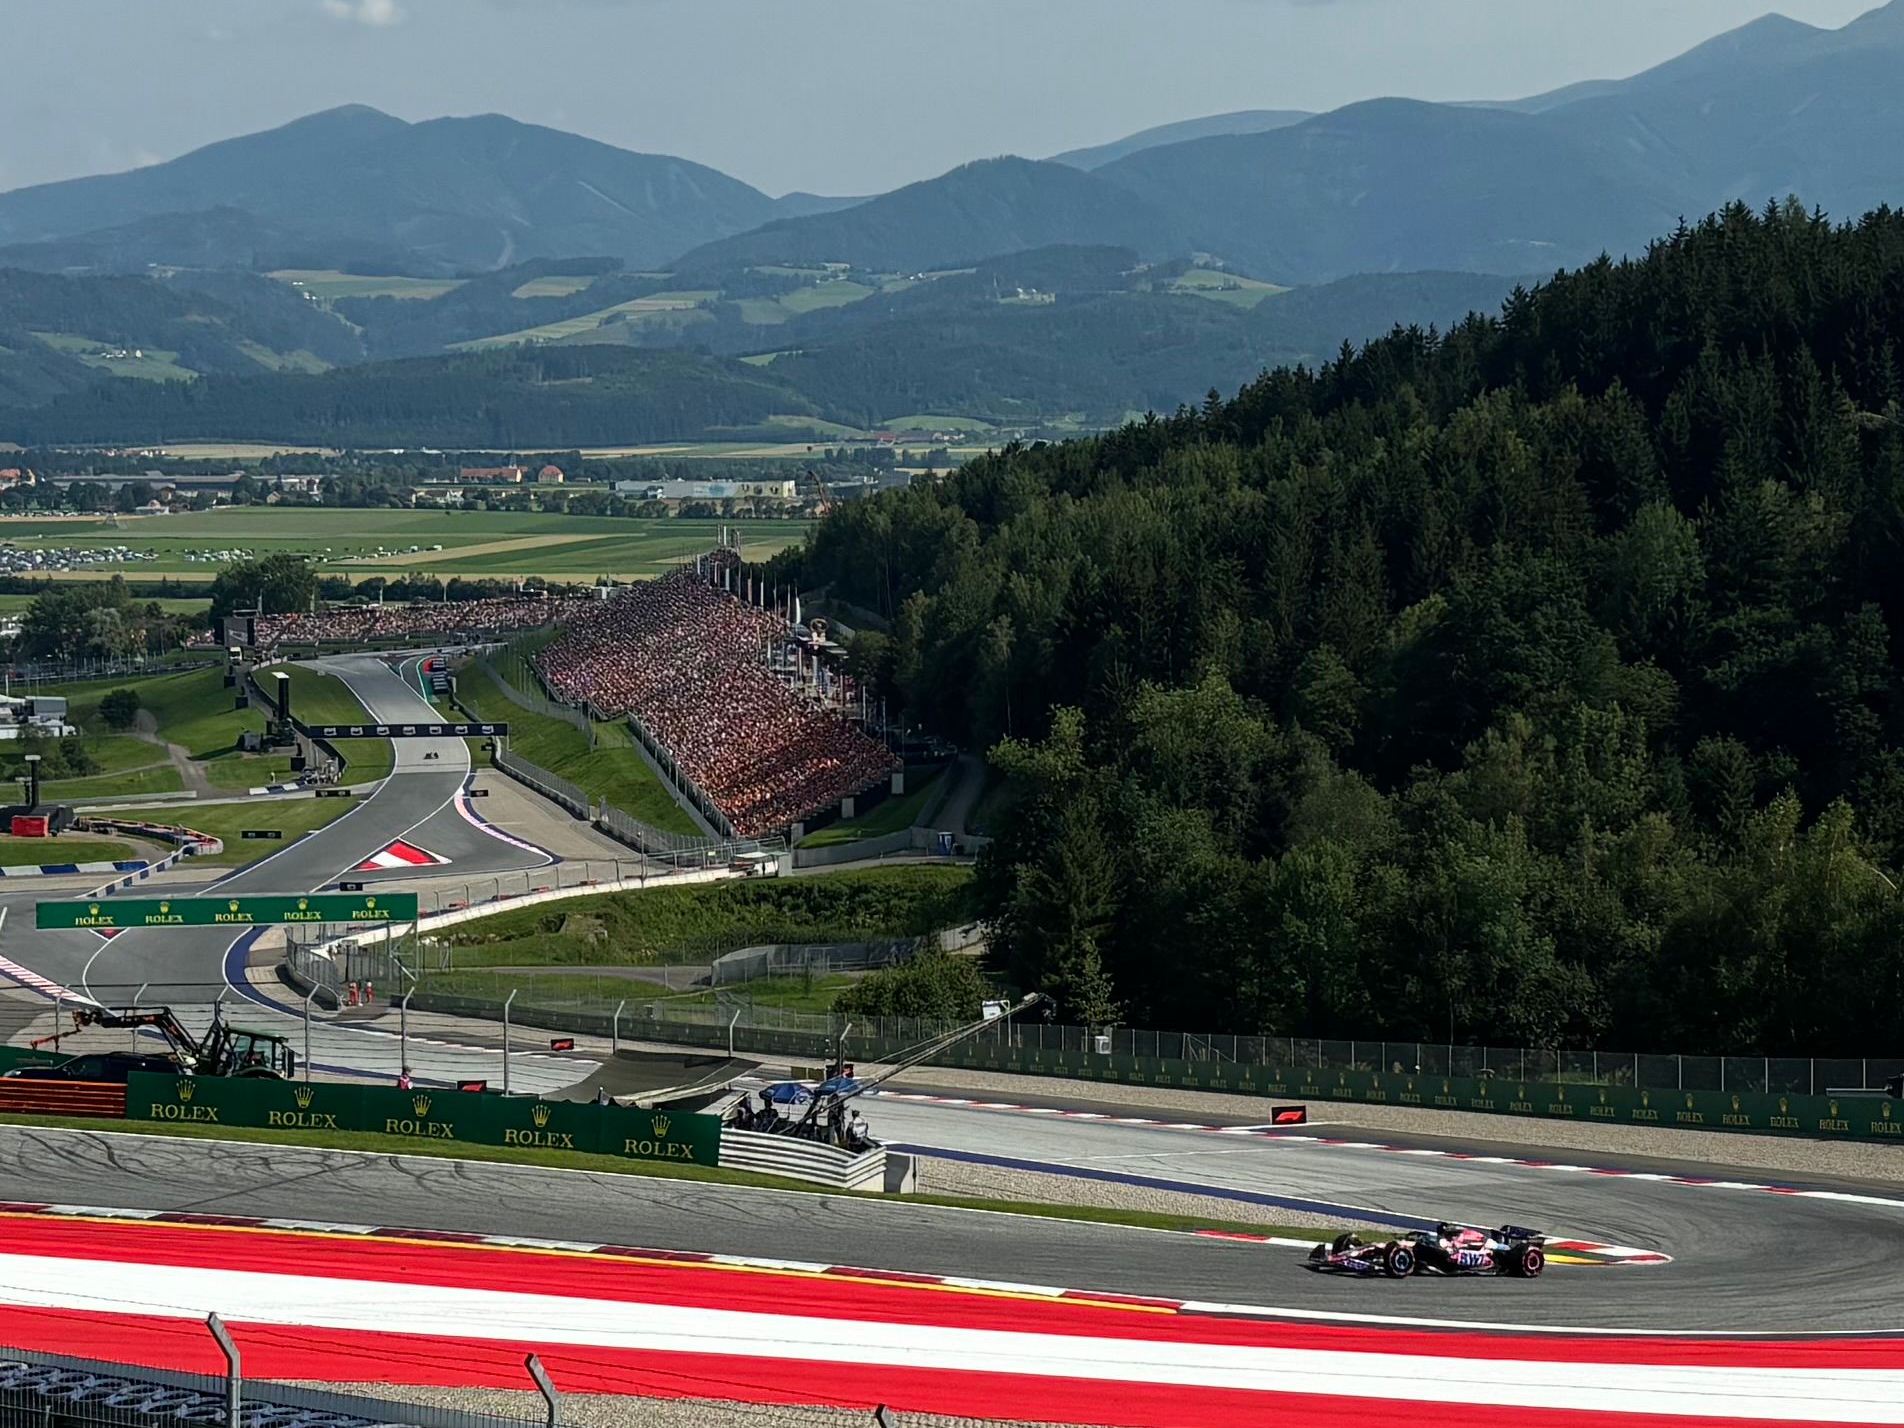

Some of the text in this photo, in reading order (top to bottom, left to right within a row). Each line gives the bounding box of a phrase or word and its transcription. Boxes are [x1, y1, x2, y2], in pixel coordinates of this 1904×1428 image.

[145, 915, 183, 924] ROLEX
[215, 913, 253, 922] ROLEX
[283, 911, 321, 921] ROLEX
[352, 910, 389, 919] ROLEX
[75, 917, 114, 926] ROLEX
[151, 1104, 218, 1121] ROLEX
[1676, 1111, 1704, 1123] ROLEX
[269, 1111, 338, 1129] ROLEX
[1722, 1114, 1750, 1126] ROLEX
[1770, 1116, 1799, 1128] ROLEX
[1819, 1119, 1849, 1131] ROLEX
[386, 1119, 454, 1138] ROLEX
[1871, 1122, 1902, 1134] ROLEX
[505, 1129, 574, 1148] ROLEX
[624, 1139, 694, 1159] ROLEX
